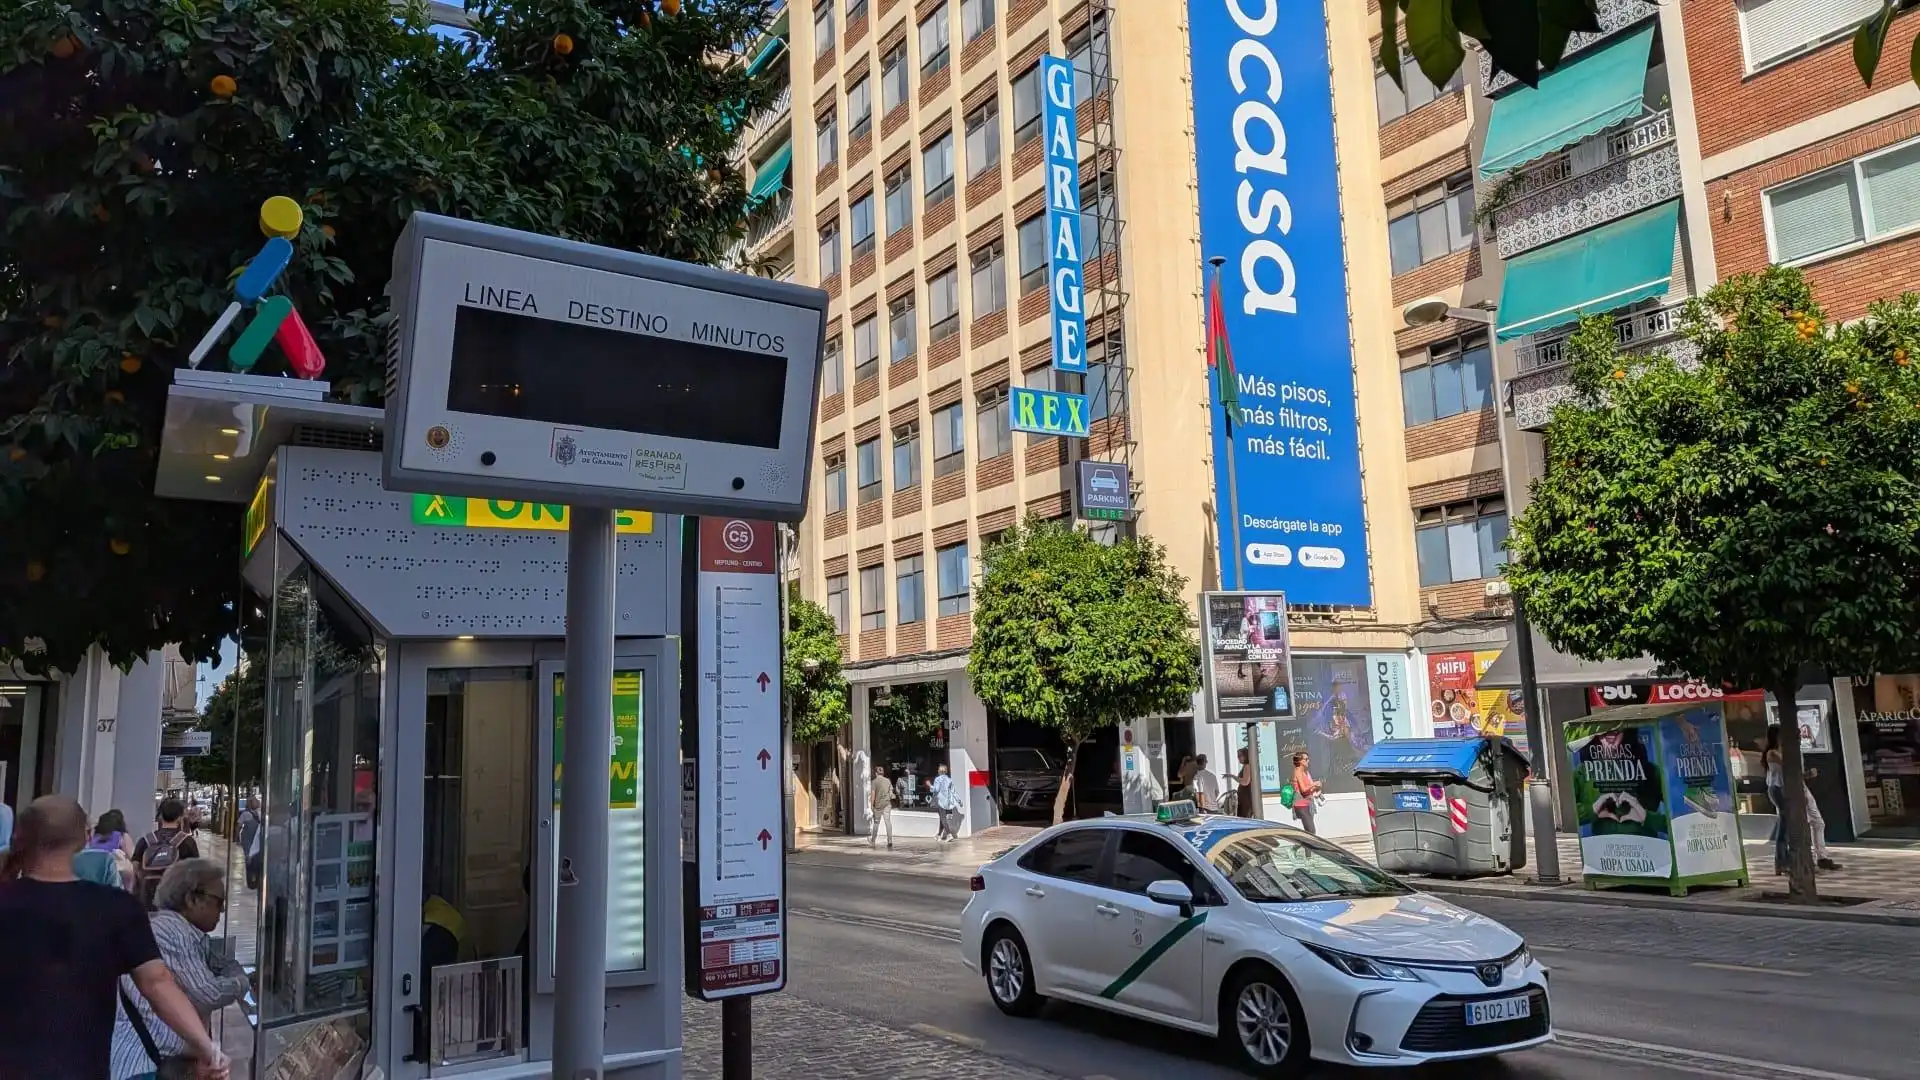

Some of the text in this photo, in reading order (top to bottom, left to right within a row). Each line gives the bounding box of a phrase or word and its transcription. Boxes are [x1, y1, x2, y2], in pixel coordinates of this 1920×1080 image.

[1047, 63, 1083, 368] GARAGE
[465, 283, 785, 352] LINEA DESTINO MINUTOS
[1238, 373, 1331, 407] Más pisos,
[1017, 391, 1086, 433] REX
[1240, 404, 1332, 436] más filtros,
[635, 448, 682, 461] GRANADA
[1247, 434, 1330, 460] más fácil.
[1087, 493, 1124, 504] PARKING
[1088, 508, 1125, 519] LIBRE
[1243, 514, 1343, 536] Descárgate la app
[729, 530, 749, 543] C5
[1436, 661, 1466, 675] SHIFU
[1859, 706, 1920, 722] APARICIO
[97, 718, 115, 733] 37
[1589, 743, 1636, 761] GRACIAS,
[1584, 760, 1648, 782] PRENDA
[1676, 756, 1719, 778] PRENDA
[1600, 857, 1656, 873] ROPA USADA
[1475, 1000, 1528, 1021] 6102 LVR
